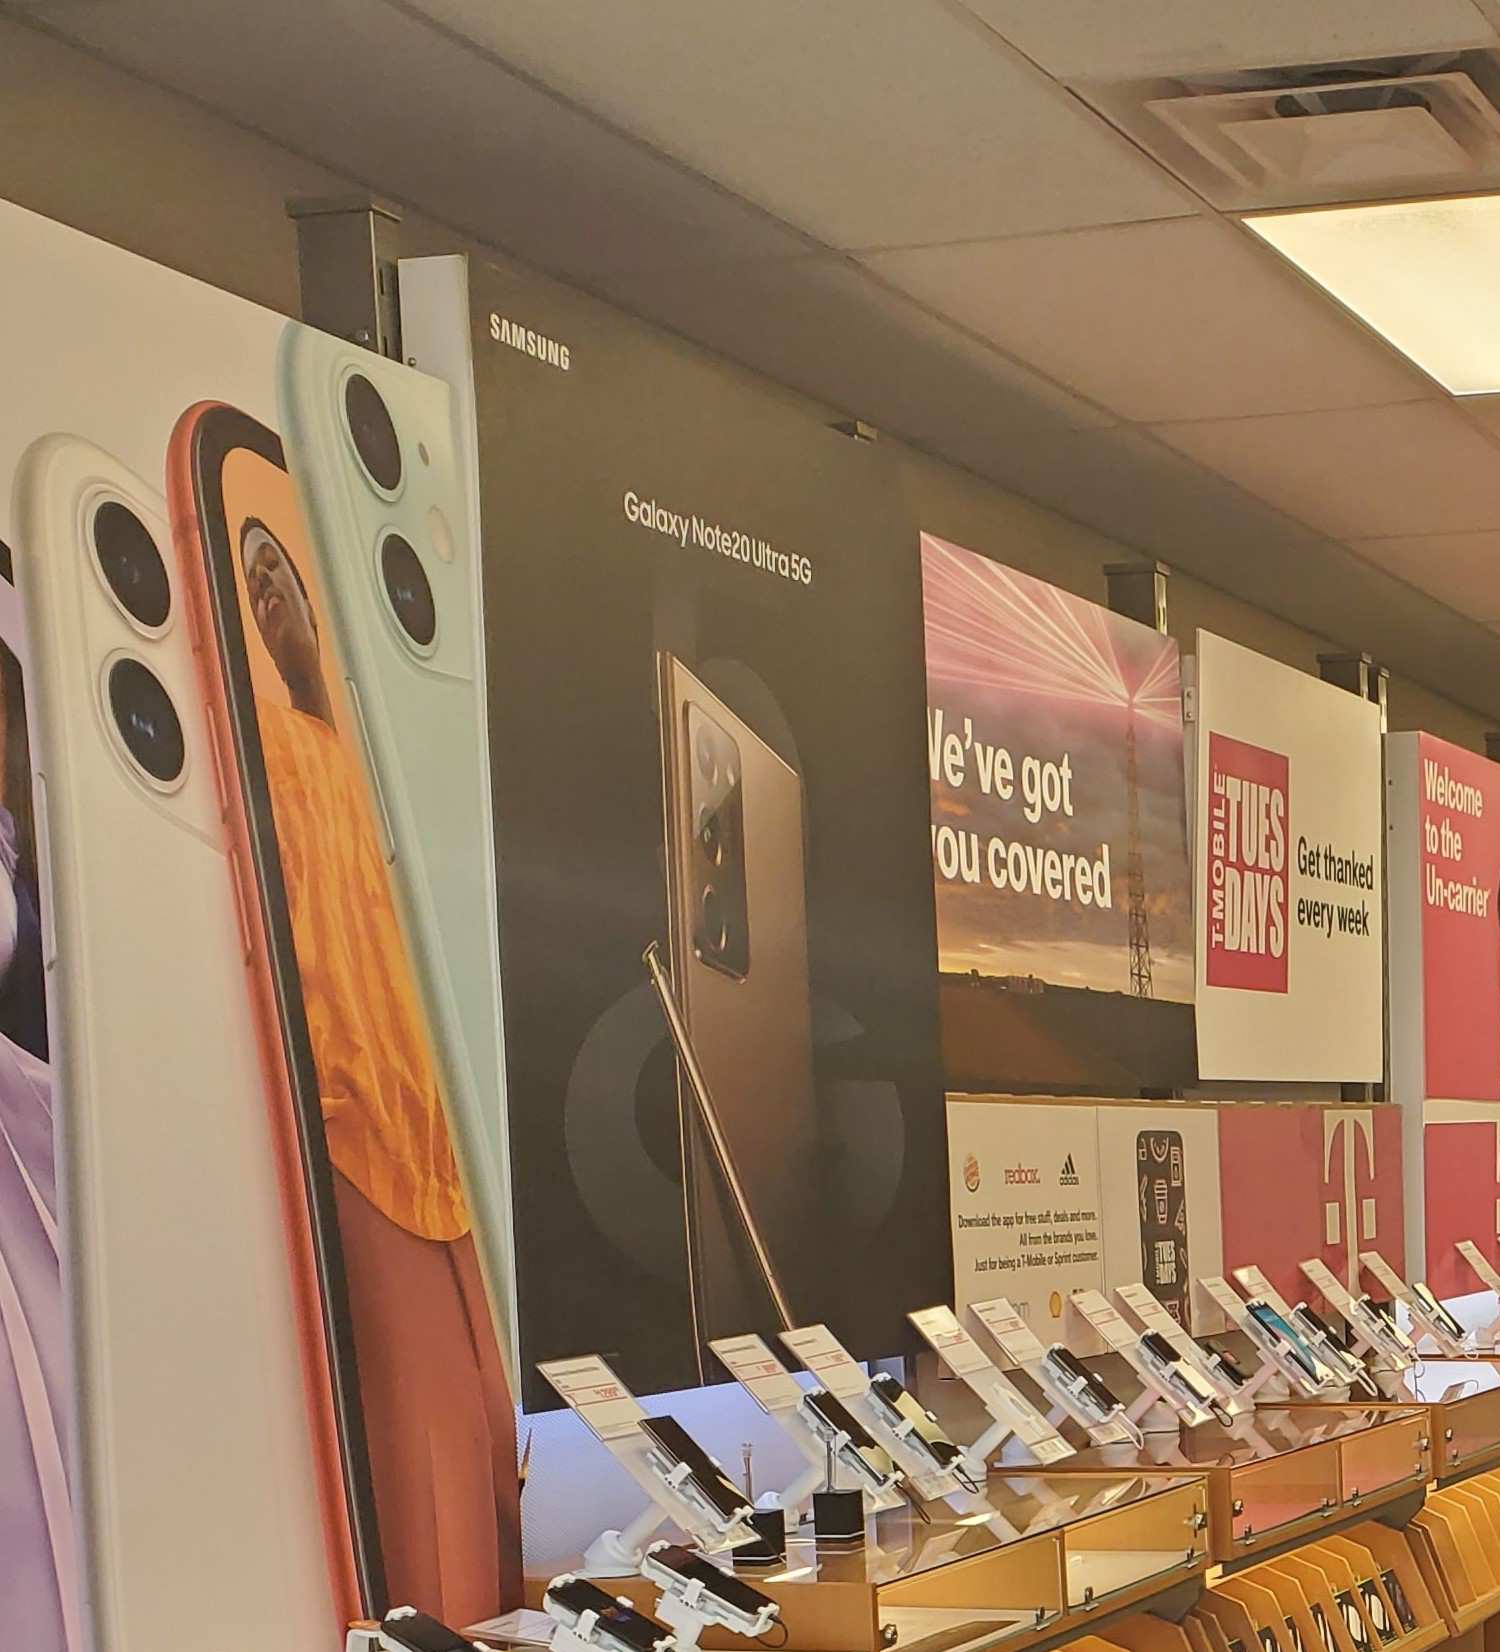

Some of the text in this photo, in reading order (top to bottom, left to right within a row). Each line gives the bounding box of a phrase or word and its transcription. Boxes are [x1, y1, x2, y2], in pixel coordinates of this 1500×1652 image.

[490, 313, 570, 371] SAMSUNG
[624, 491, 812, 585] Galaxy Note20 Ultra 5G
[1022, 752, 1073, 823] got
[1424, 758, 1483, 818] Welcome
[1226, 775, 1285, 873] TUES
[1425, 815, 1462, 861] to the
[931, 825, 1112, 908] ou covered
[1212, 770, 1226, 949] T-MOBILE
[1297, 835, 1374, 890] Get thanked
[1224, 866, 1285, 959] DAYS
[1297, 897, 1370, 939] every week
[1426, 863, 1489, 918] Un-carrier
[991, 1212, 1001, 1227] the
[1002, 1214, 1015, 1230] app
[1015, 1211, 1024, 1225] for
[1043, 1232, 1052, 1244] the
